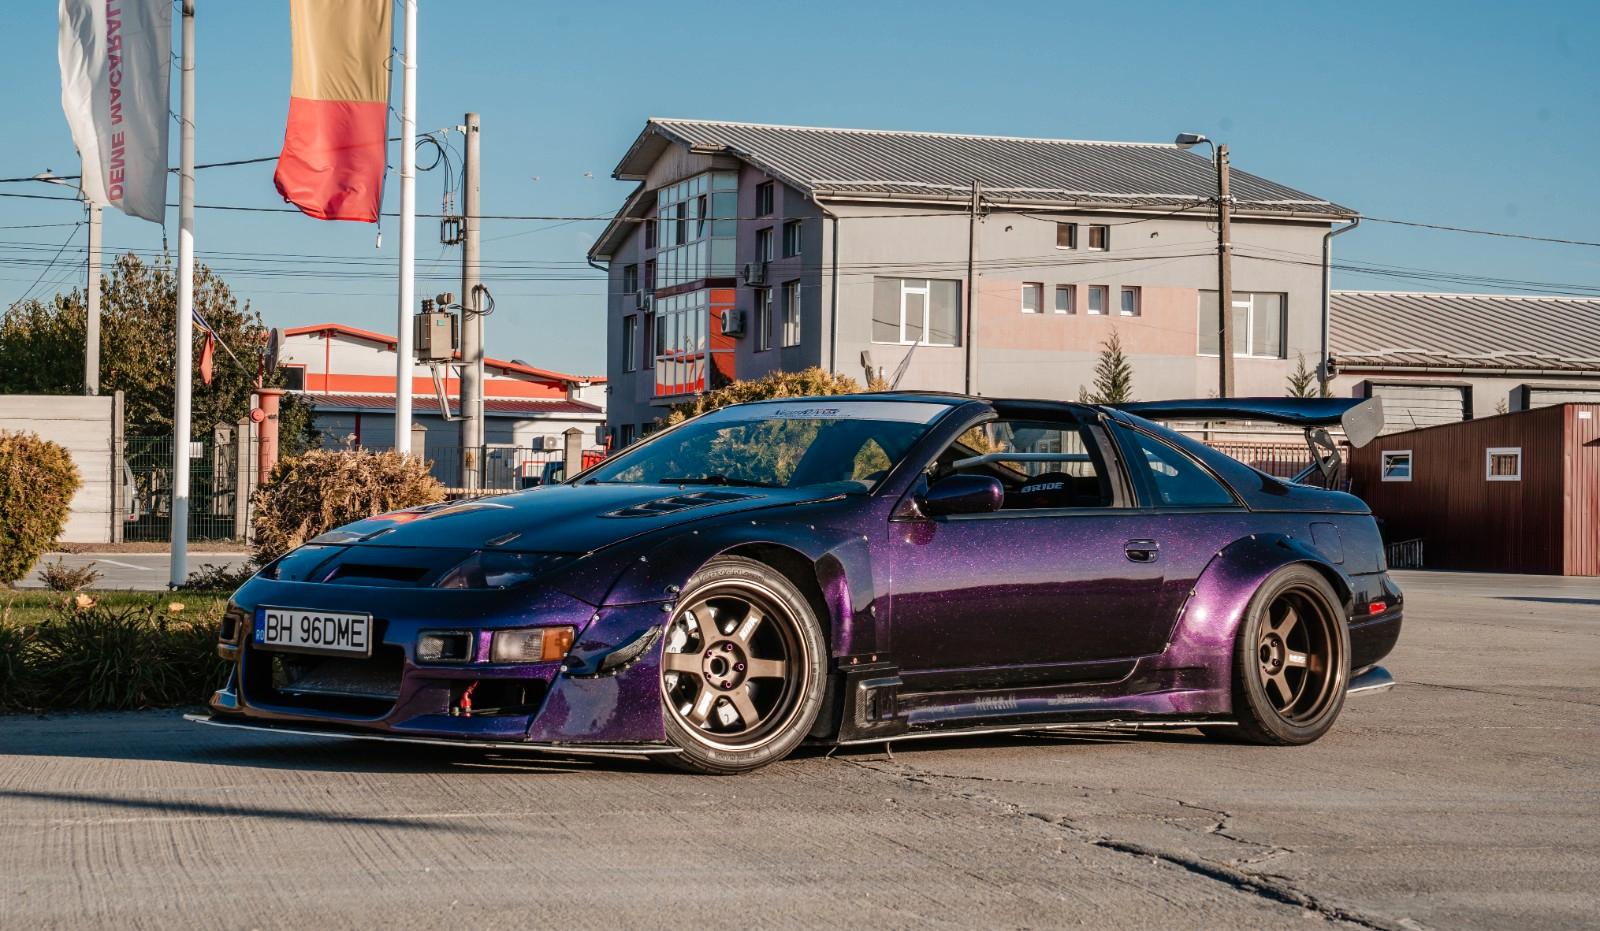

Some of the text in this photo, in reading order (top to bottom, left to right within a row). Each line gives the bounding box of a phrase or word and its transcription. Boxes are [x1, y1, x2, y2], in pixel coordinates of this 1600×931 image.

[1021, 482, 1064, 493] BRIDE
[255, 629, 264, 641] RO
[266, 614, 365, 648] BH 96DME
